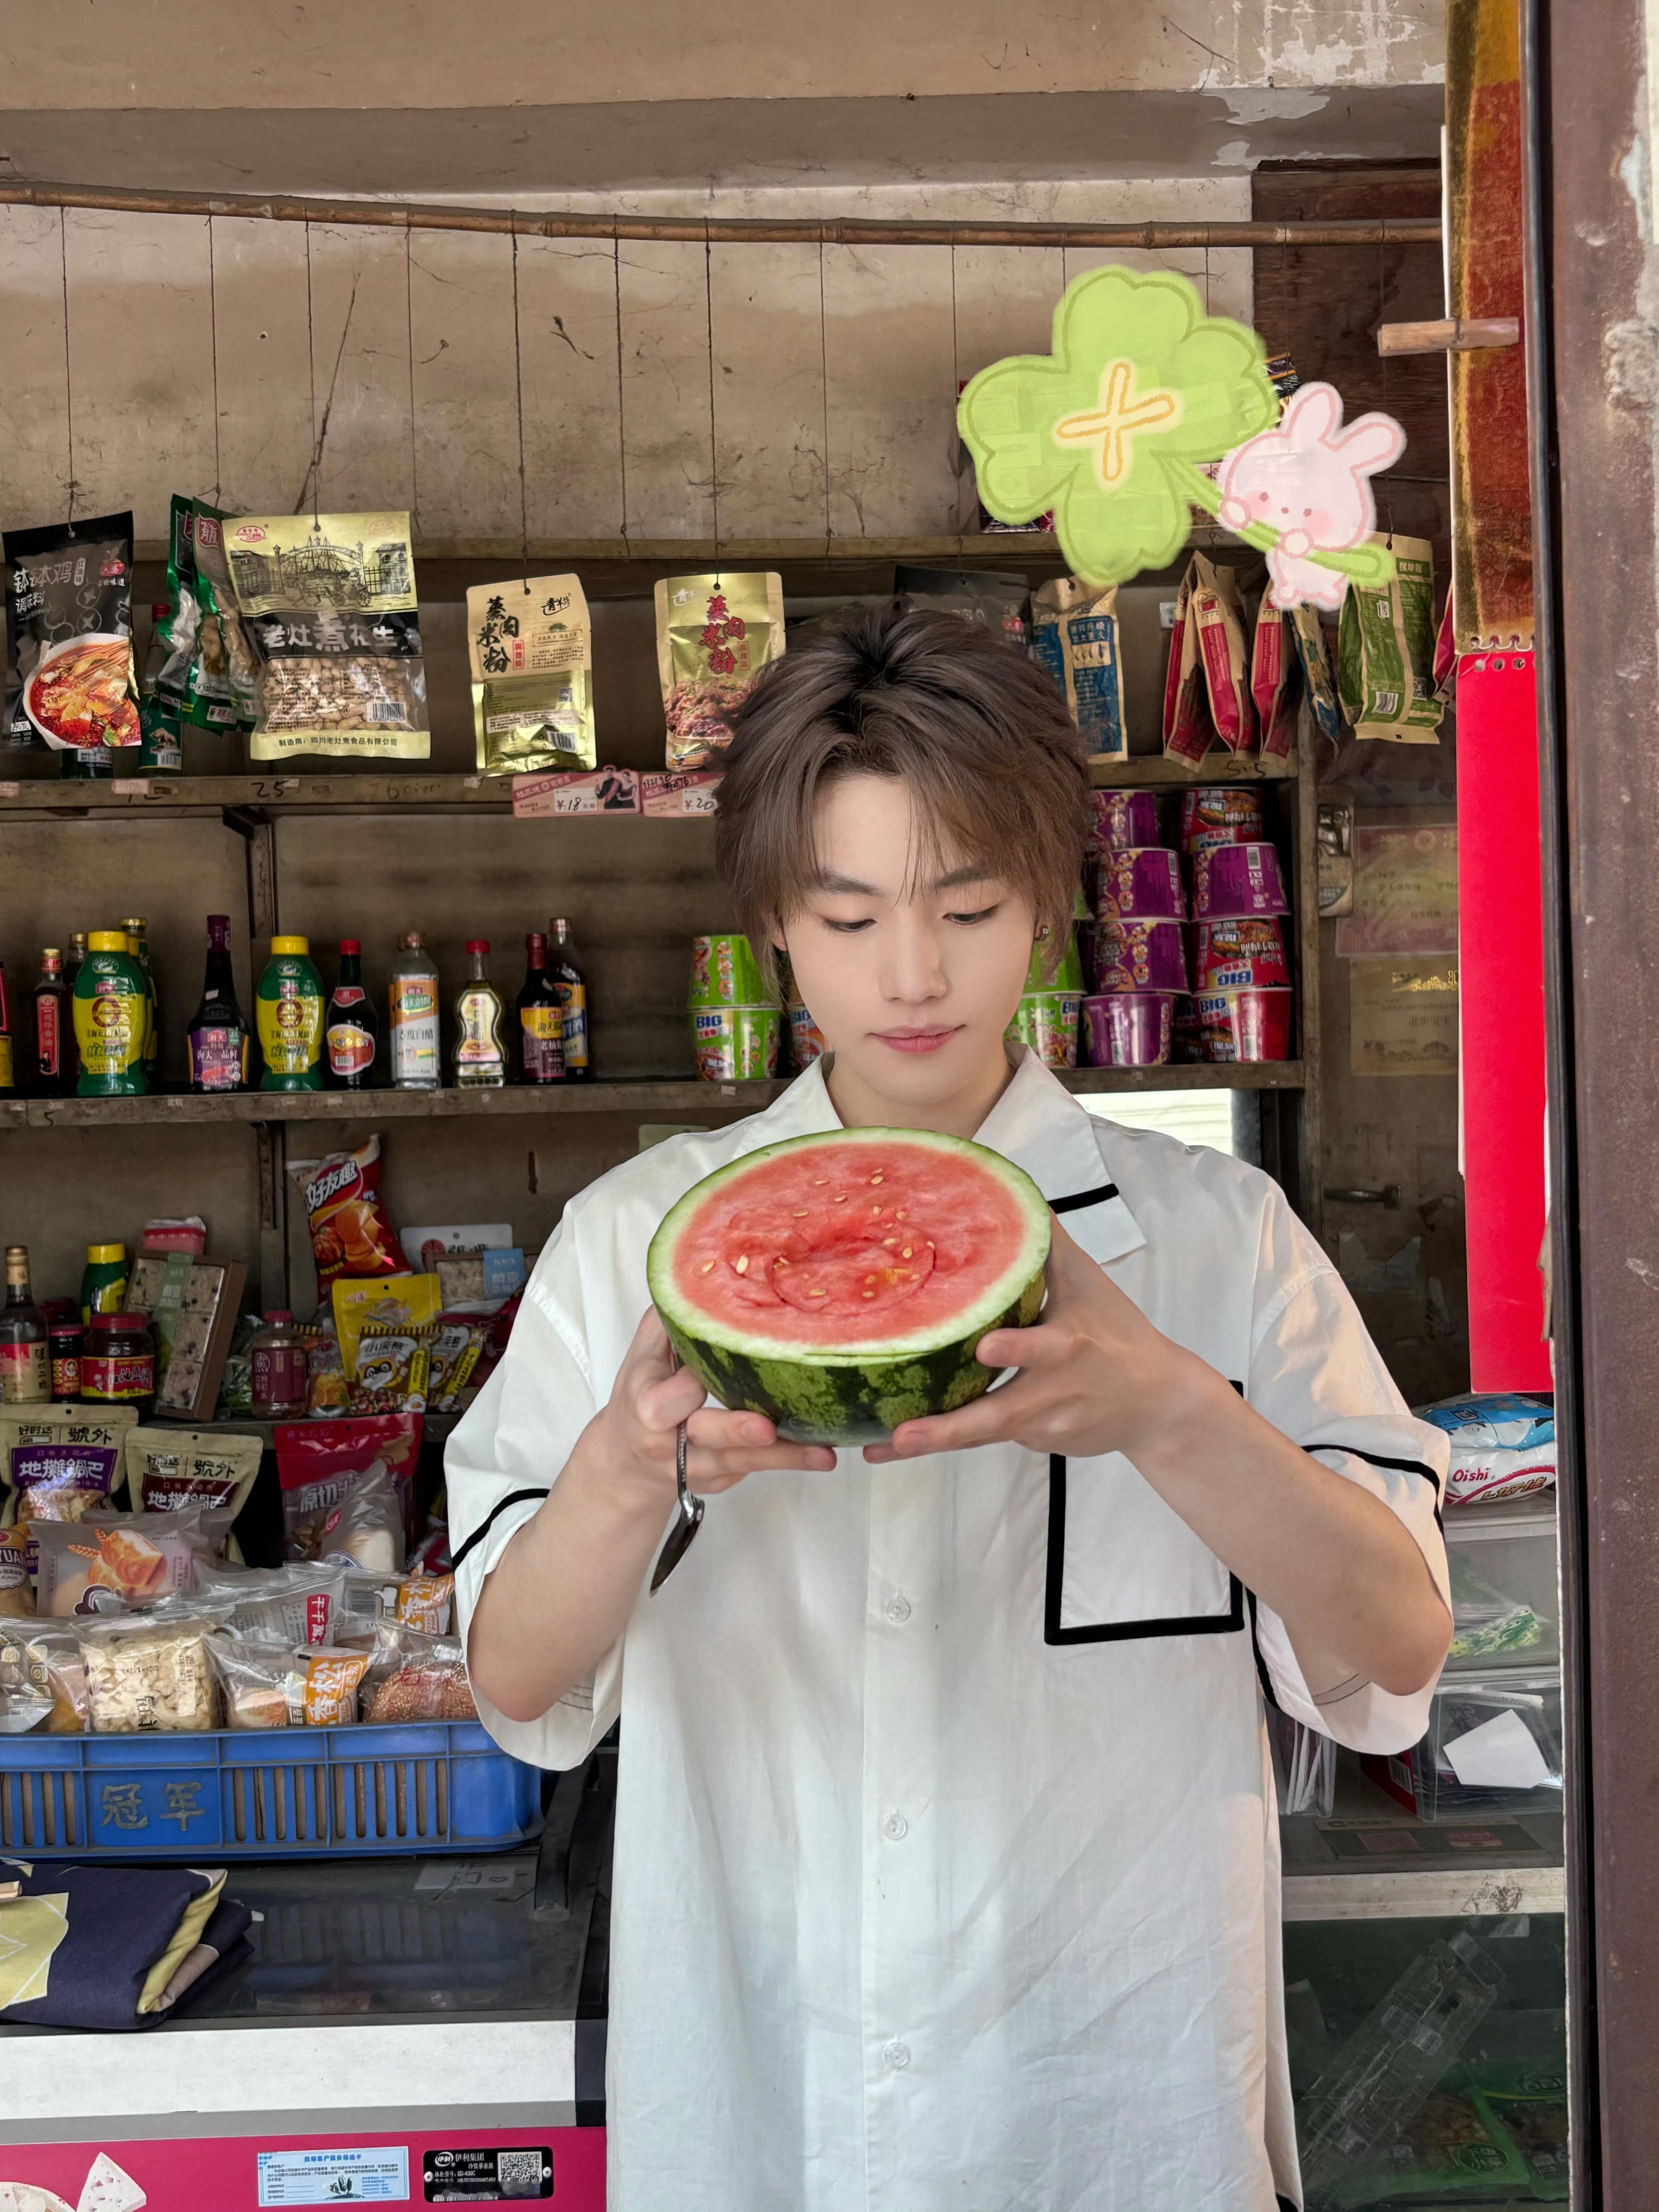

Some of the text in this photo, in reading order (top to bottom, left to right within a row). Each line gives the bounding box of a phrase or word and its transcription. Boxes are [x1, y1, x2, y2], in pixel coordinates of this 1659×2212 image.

[13, 561, 73, 593] 钵钵鸡
[541, 594, 572, 616] 青羊坊
[1218, 969, 1252, 986] BIG
[1199, 997, 1226, 1013] BIG
[696, 1015, 722, 1029] BIG
[305, 1160, 358, 1214] 好友趣
[68, 1427, 113, 1444] 號外
[193, 1460, 236, 1479] 號外
[1452, 1467, 1490, 1483] Oishi
[1481, 1476, 1547, 1500] 上好佳
[100, 1782, 206, 1832] 冠军
[455, 2152, 484, 2162] 伊利集团
